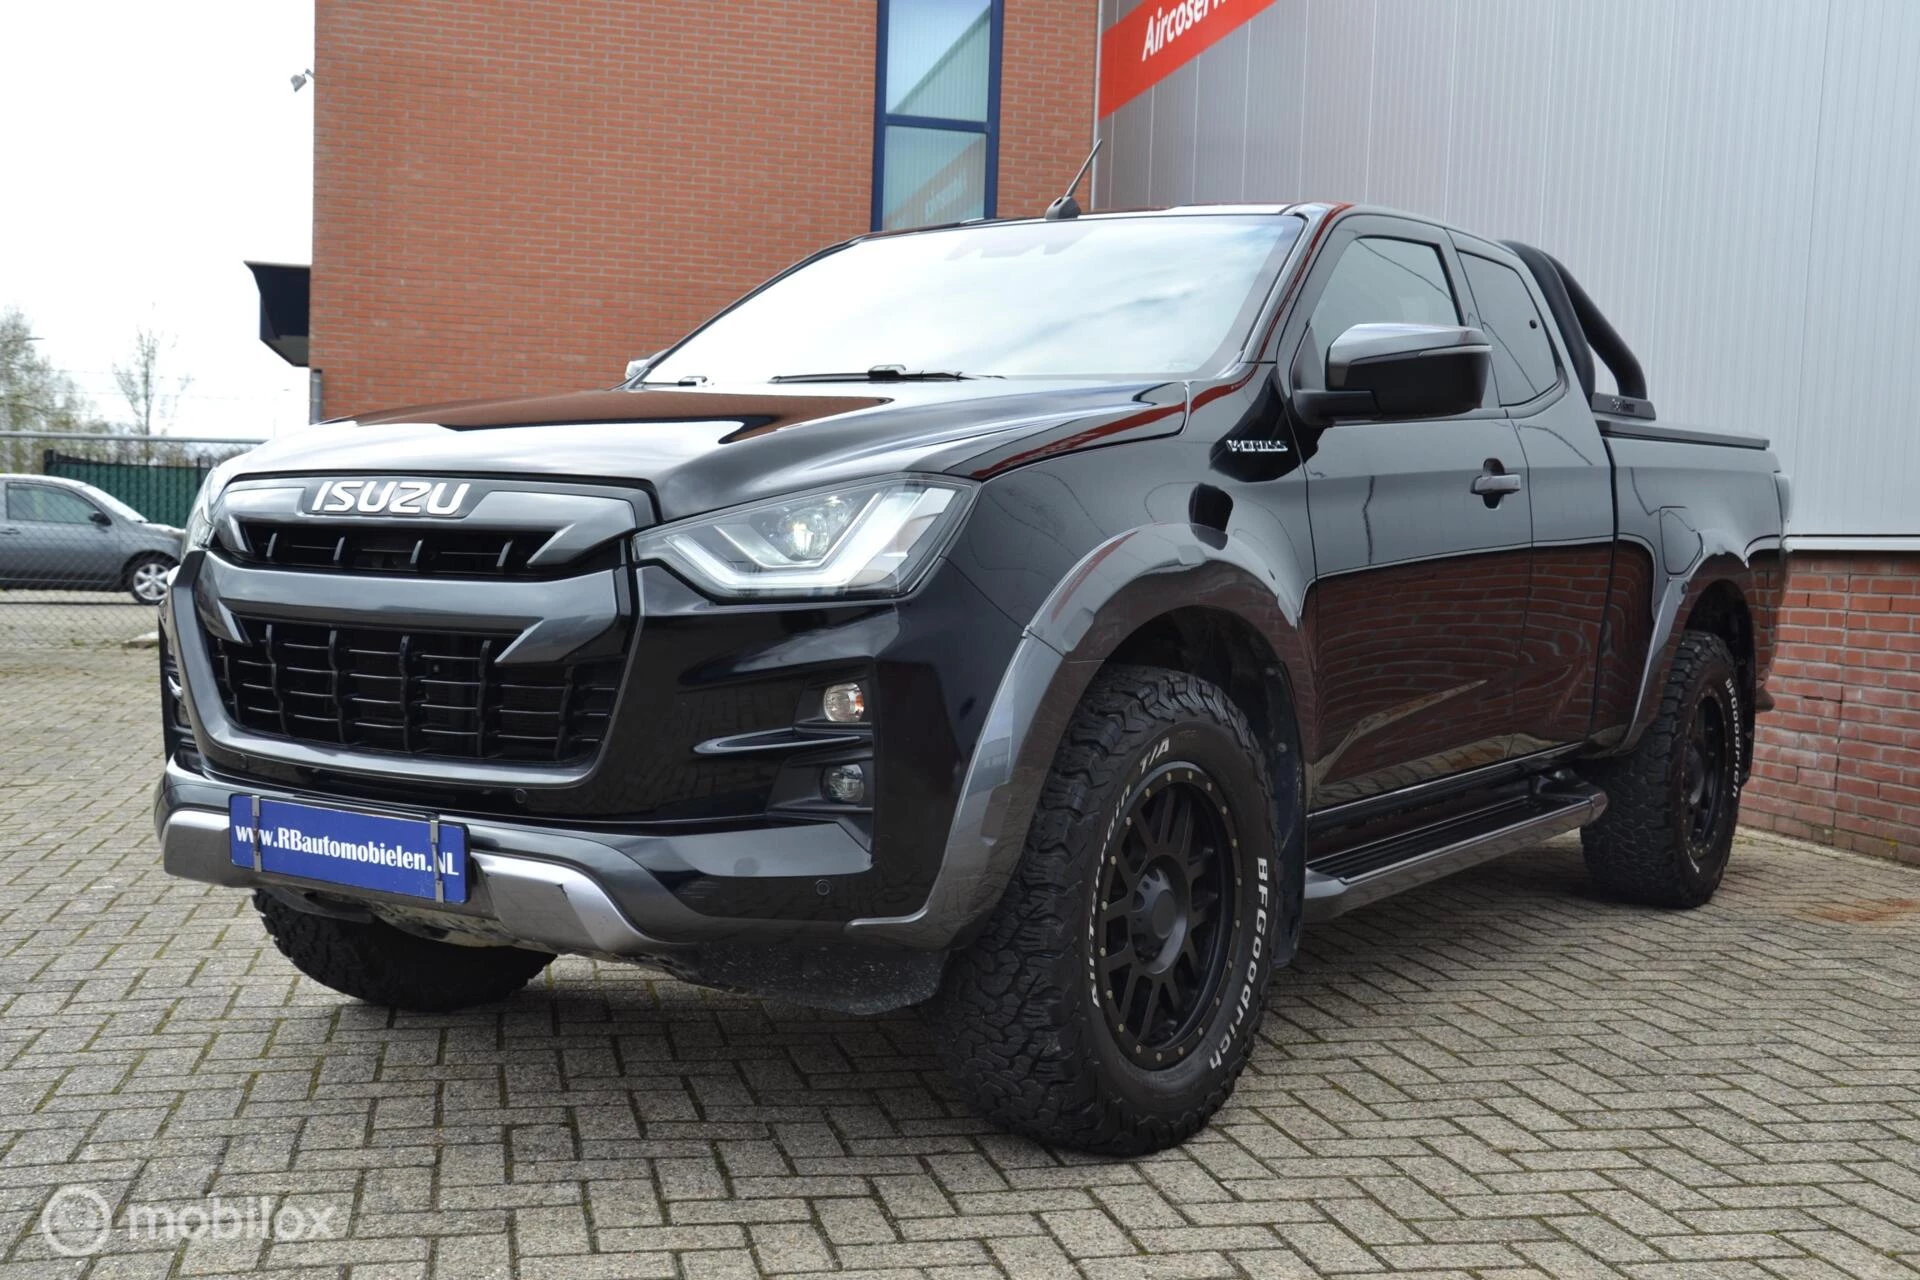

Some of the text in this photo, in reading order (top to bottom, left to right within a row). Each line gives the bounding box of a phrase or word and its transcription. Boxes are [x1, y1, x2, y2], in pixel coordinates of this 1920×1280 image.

[311, 480, 471, 515] ISUZU
[1140, 737, 1170, 775] T/A
[235, 825, 460, 876] www.RBautomobielen.NL
[1209, 857, 1269, 1070] BFGoodrich
